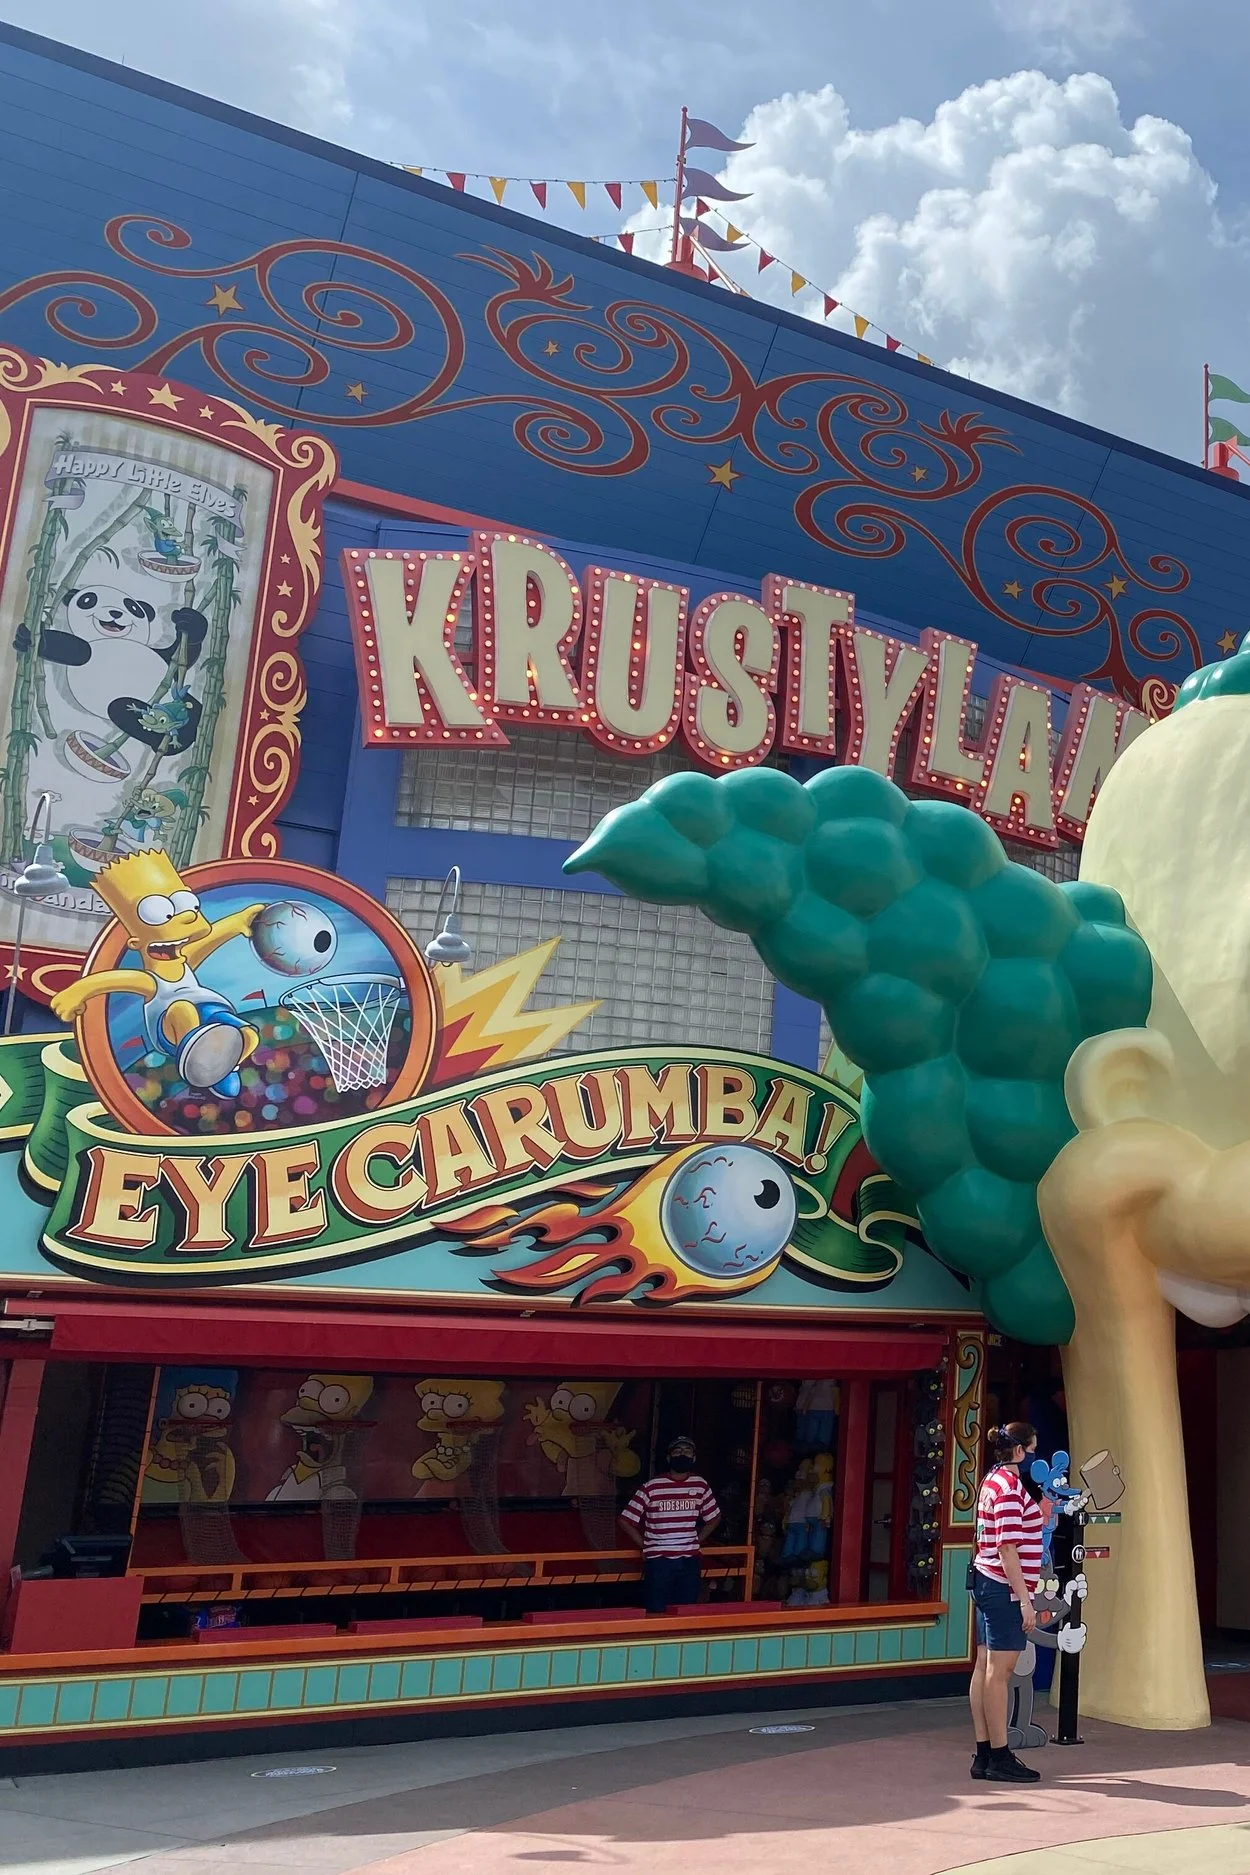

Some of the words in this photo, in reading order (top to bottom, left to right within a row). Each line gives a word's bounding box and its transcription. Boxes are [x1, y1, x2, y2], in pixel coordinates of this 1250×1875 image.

[54, 453, 124, 478] Happy
[128, 463, 182, 493] Little
[187, 483, 237, 518] Elves
[70, 1142, 324, 1252] EYE
[333, 1063, 858, 1224] CARUMBA!
[660, 1500, 696, 1511] SIDESHOW
